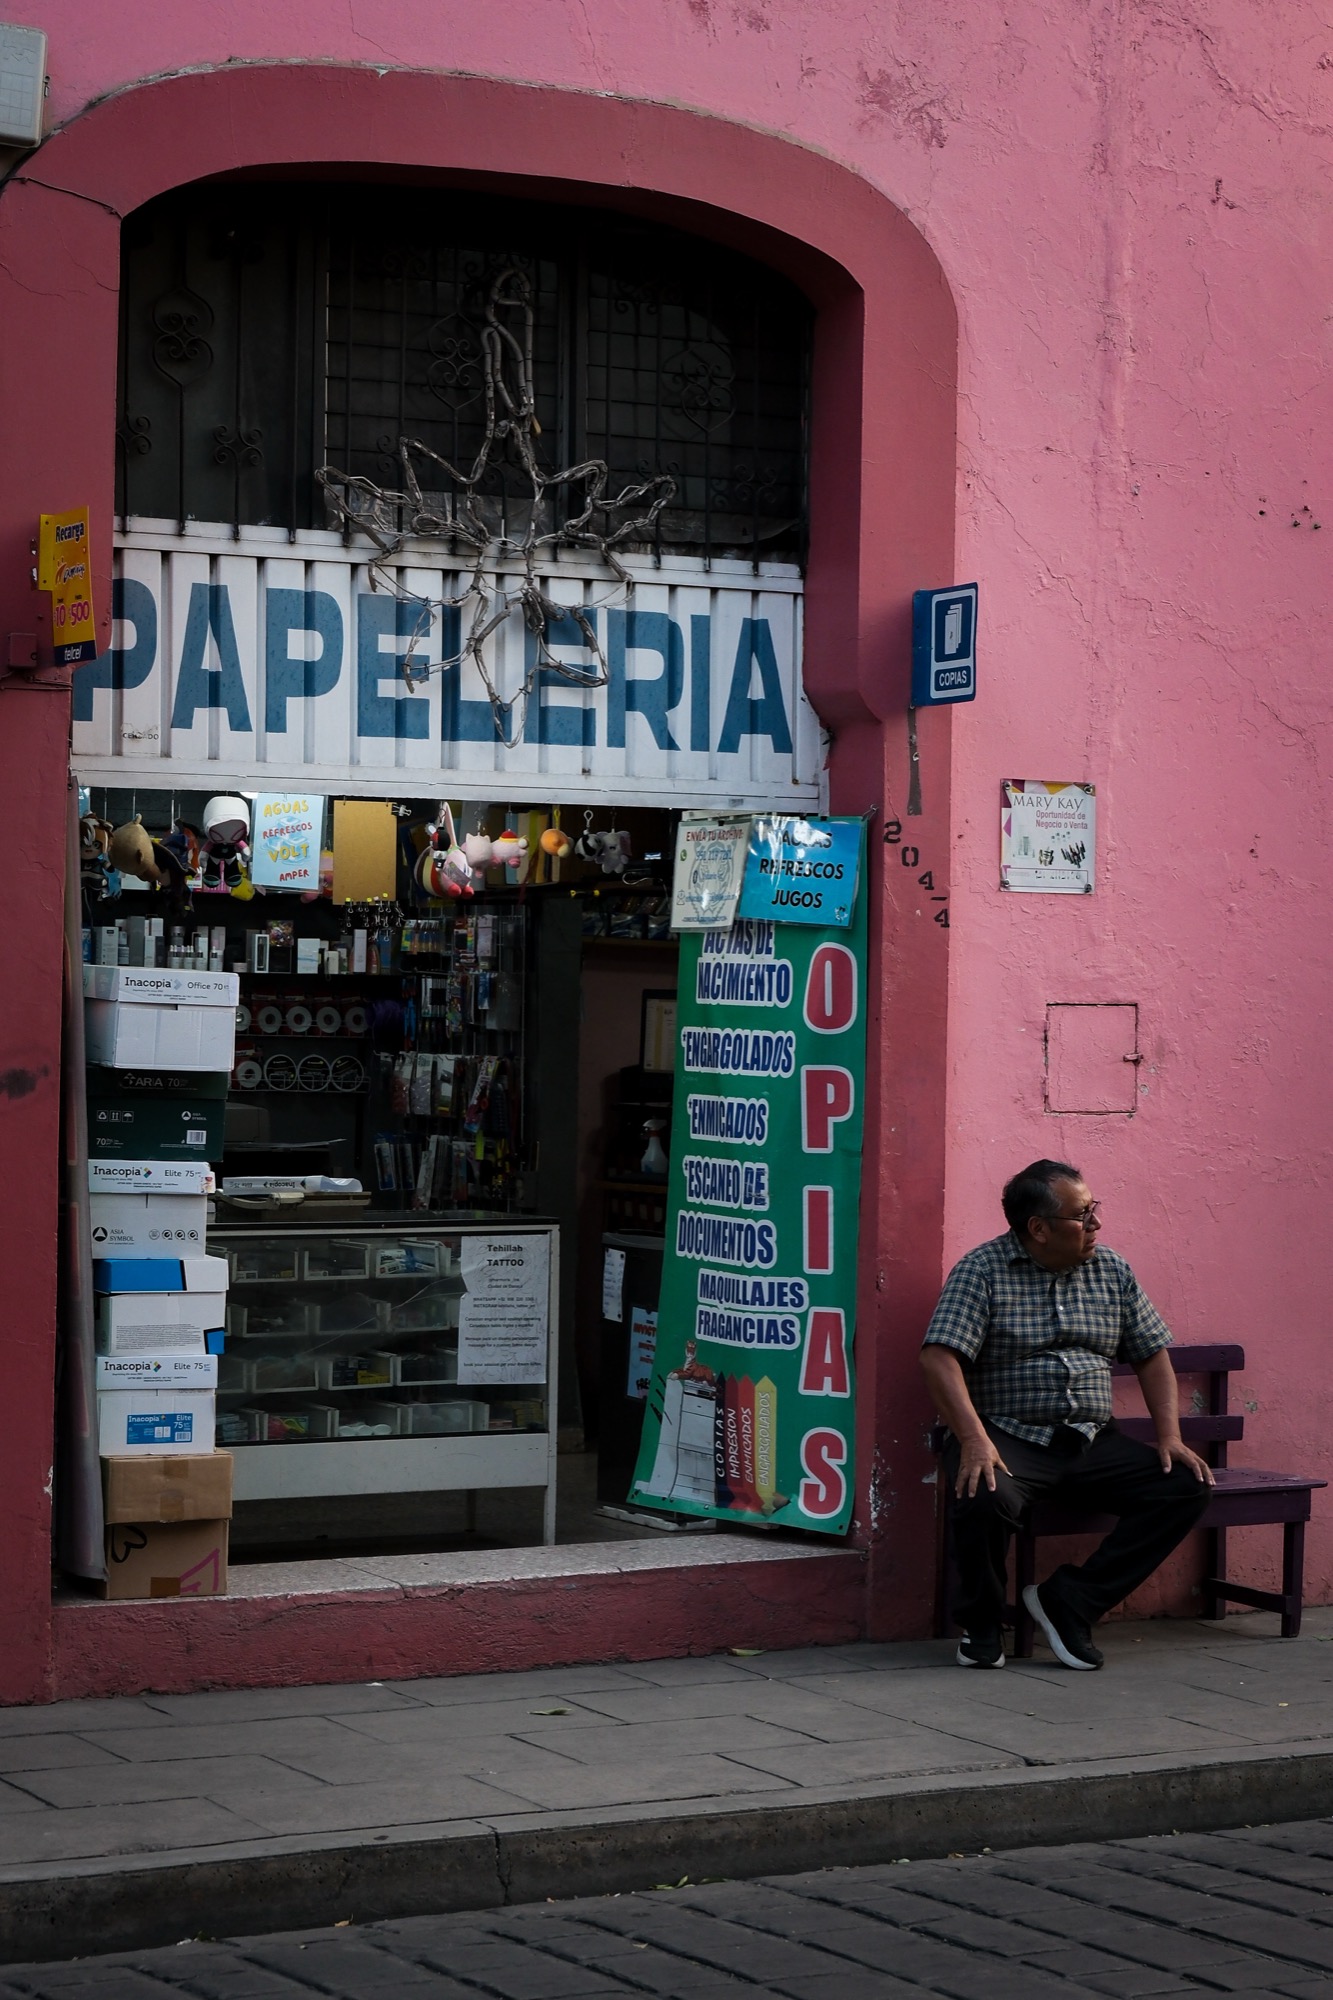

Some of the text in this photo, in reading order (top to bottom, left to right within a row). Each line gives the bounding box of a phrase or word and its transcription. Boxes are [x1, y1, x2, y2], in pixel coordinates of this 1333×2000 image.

[55, 522, 85, 543] Recarga
[64, 645, 82, 661] telcel
[73, 578, 793, 754] PAPELERIA
[938, 669, 968, 686] COPIAS
[263, 800, 309, 817] AGUAS
[1013, 795, 1084, 812] MARY KAY
[1035, 810, 1086, 820] Oportunidad de
[1035, 820, 1062, 829] Negocio
[1069, 821, 1088, 829] Venta
[262, 822, 313, 839] REFRESCOS
[268, 843, 309, 862] VOLT
[279, 869, 310, 881] AMPER
[759, 858, 844, 880] REFRESCOS
[771, 889, 823, 909] JUGOS
[754, 920, 773, 955] DE
[124, 976, 172, 989] Inacopia
[187, 981, 211, 990] Office
[213, 982, 223, 991] 70
[697, 962, 790, 1003] NACIMIENTO
[93, 1165, 195, 1178] Inacopia Elite 75
[744, 1167, 766, 1206] DE
[679, 1215, 774, 1264] DOCUMENTOS
[487, 1259, 524, 1267] TATTOO
[699, 1272, 805, 1308] MAQUILLAJES
[697, 1309, 796, 1346] FRAGANCIAS
[104, 1361, 204, 1372] Inacopia Elite 75
[128, 1415, 160, 1424] Inacopia
[715, 1407, 725, 1478] COPIAS
[727, 1408, 740, 1478] IMPRESION
[741, 1406, 753, 1483] ENMICADOS
[758, 1391, 771, 1486] ENGARGOLADOS
